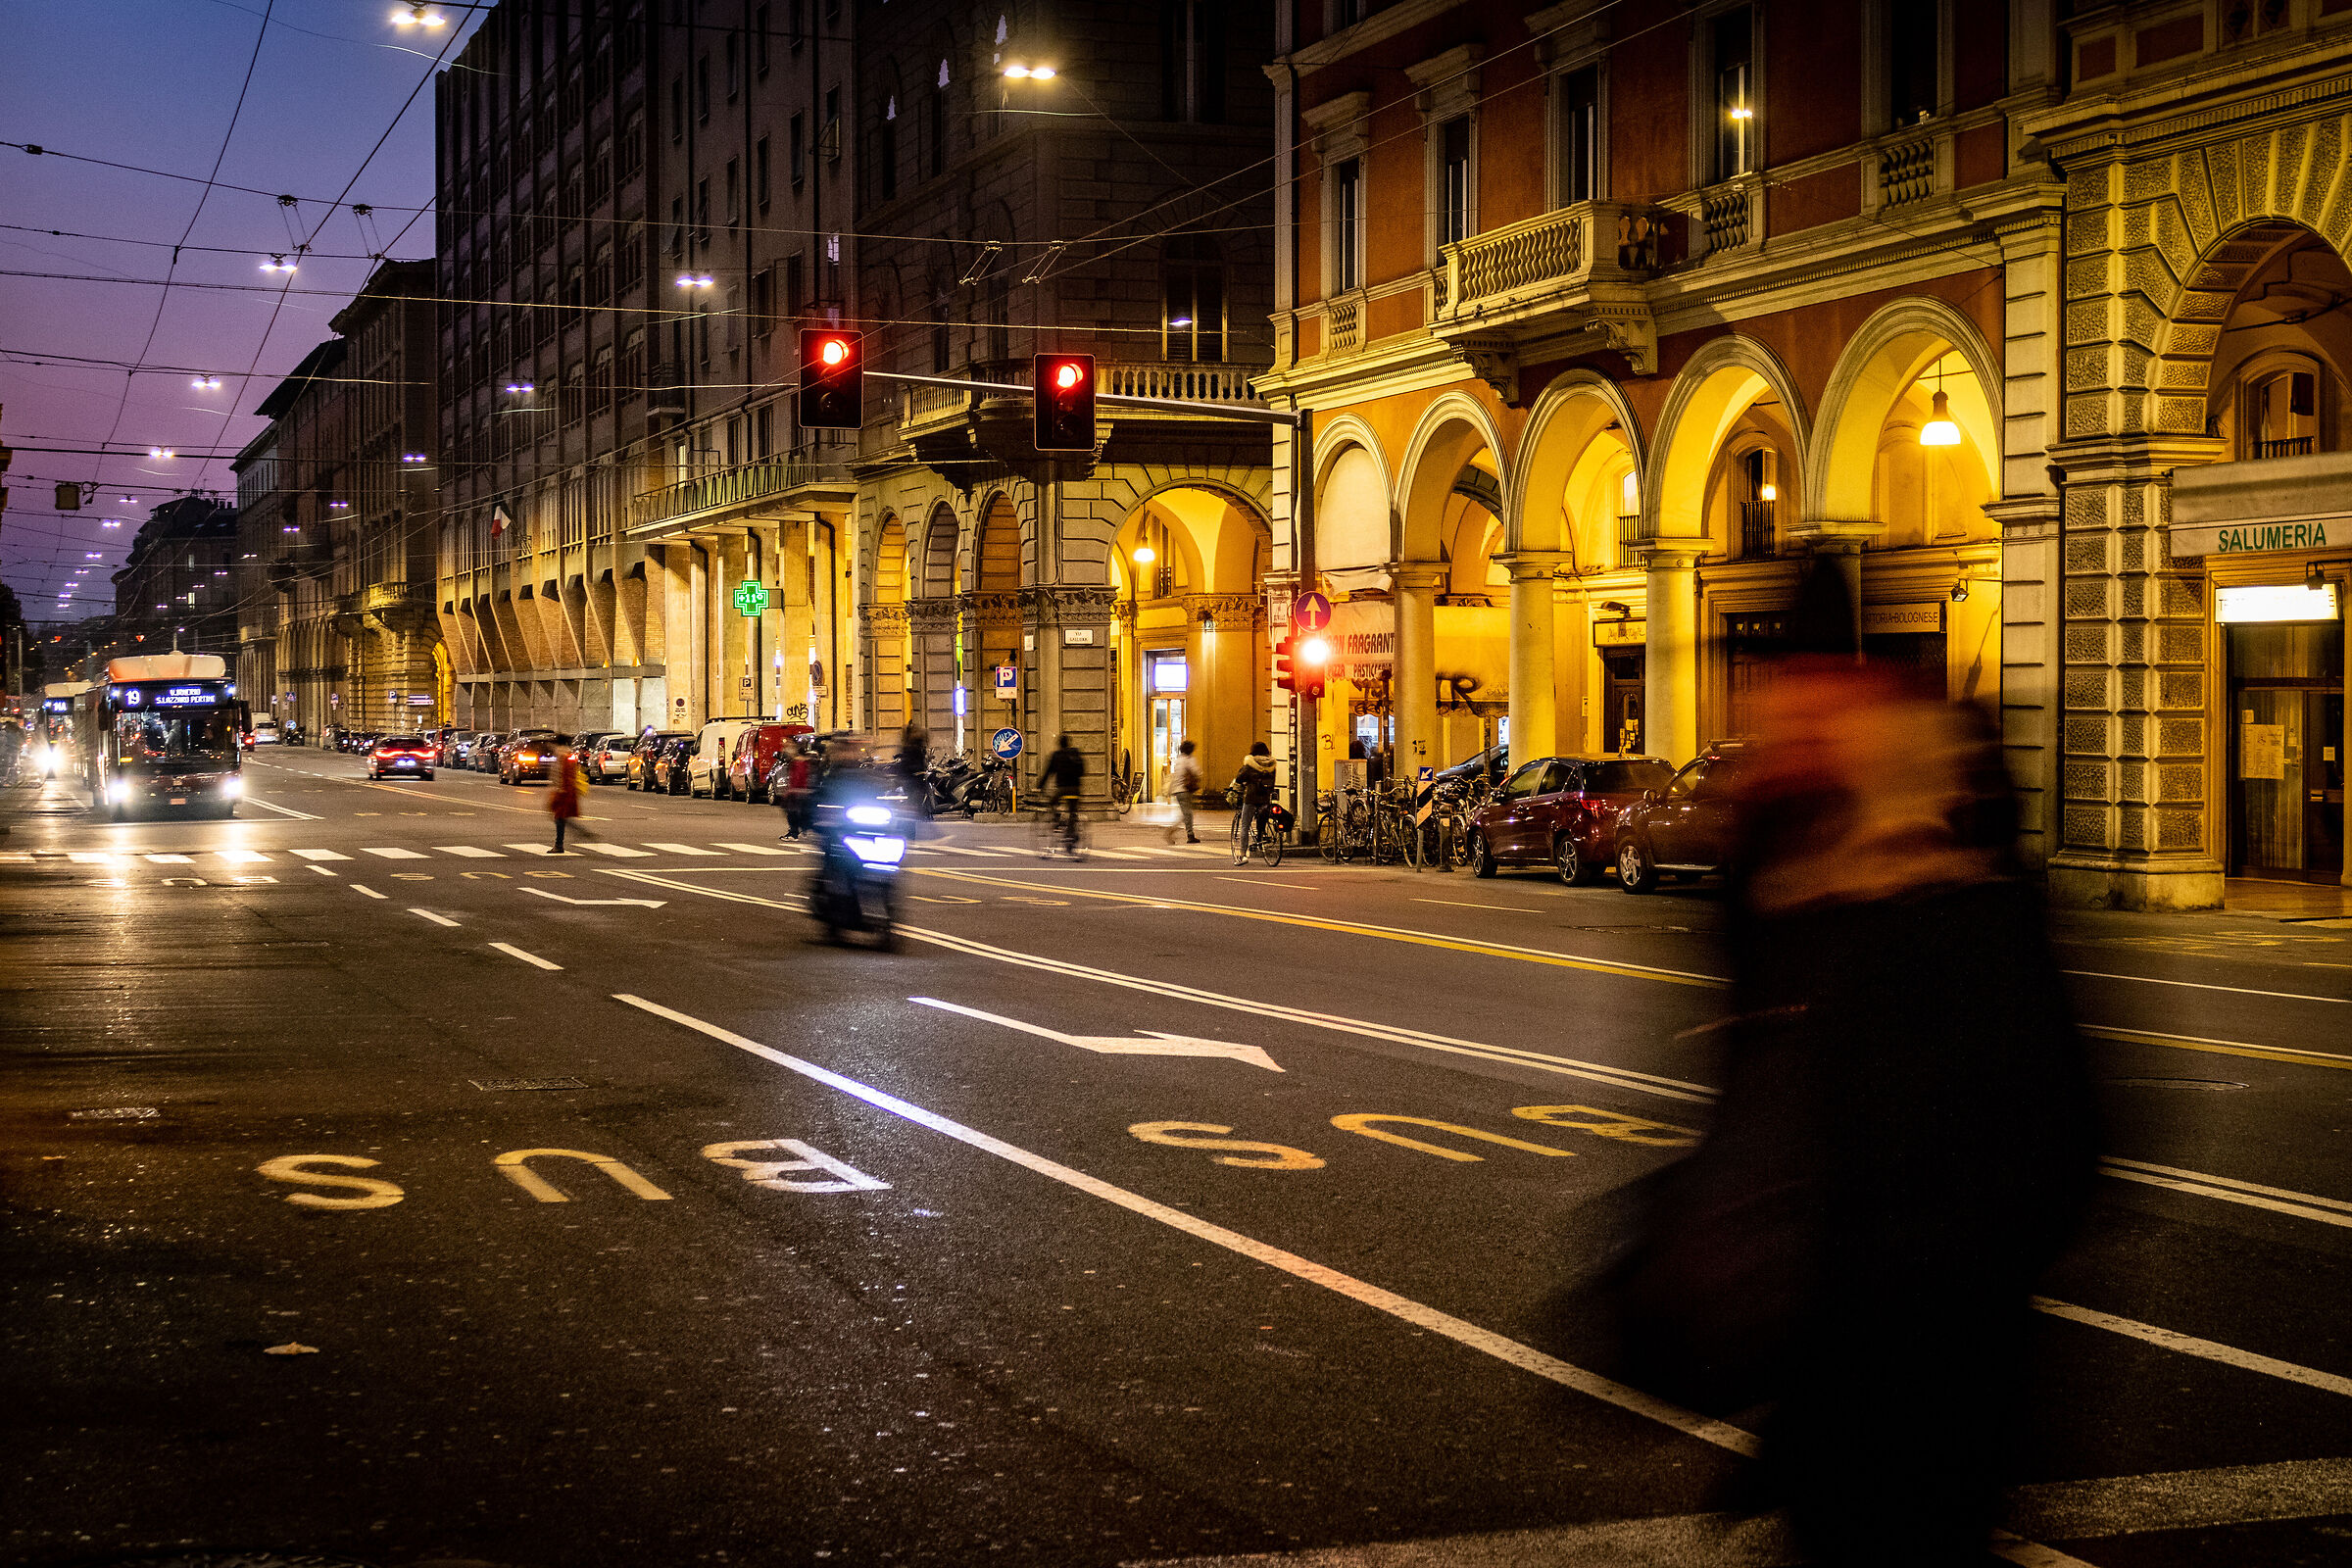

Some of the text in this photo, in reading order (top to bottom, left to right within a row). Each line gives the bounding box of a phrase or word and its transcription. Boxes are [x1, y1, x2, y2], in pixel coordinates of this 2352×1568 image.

[2218, 522, 2327, 552] SALUMERIA
[125, 690, 140, 705] 19
[1127, 1104, 1705, 1171] BUS
[257, 1138, 893, 1210] BUS
